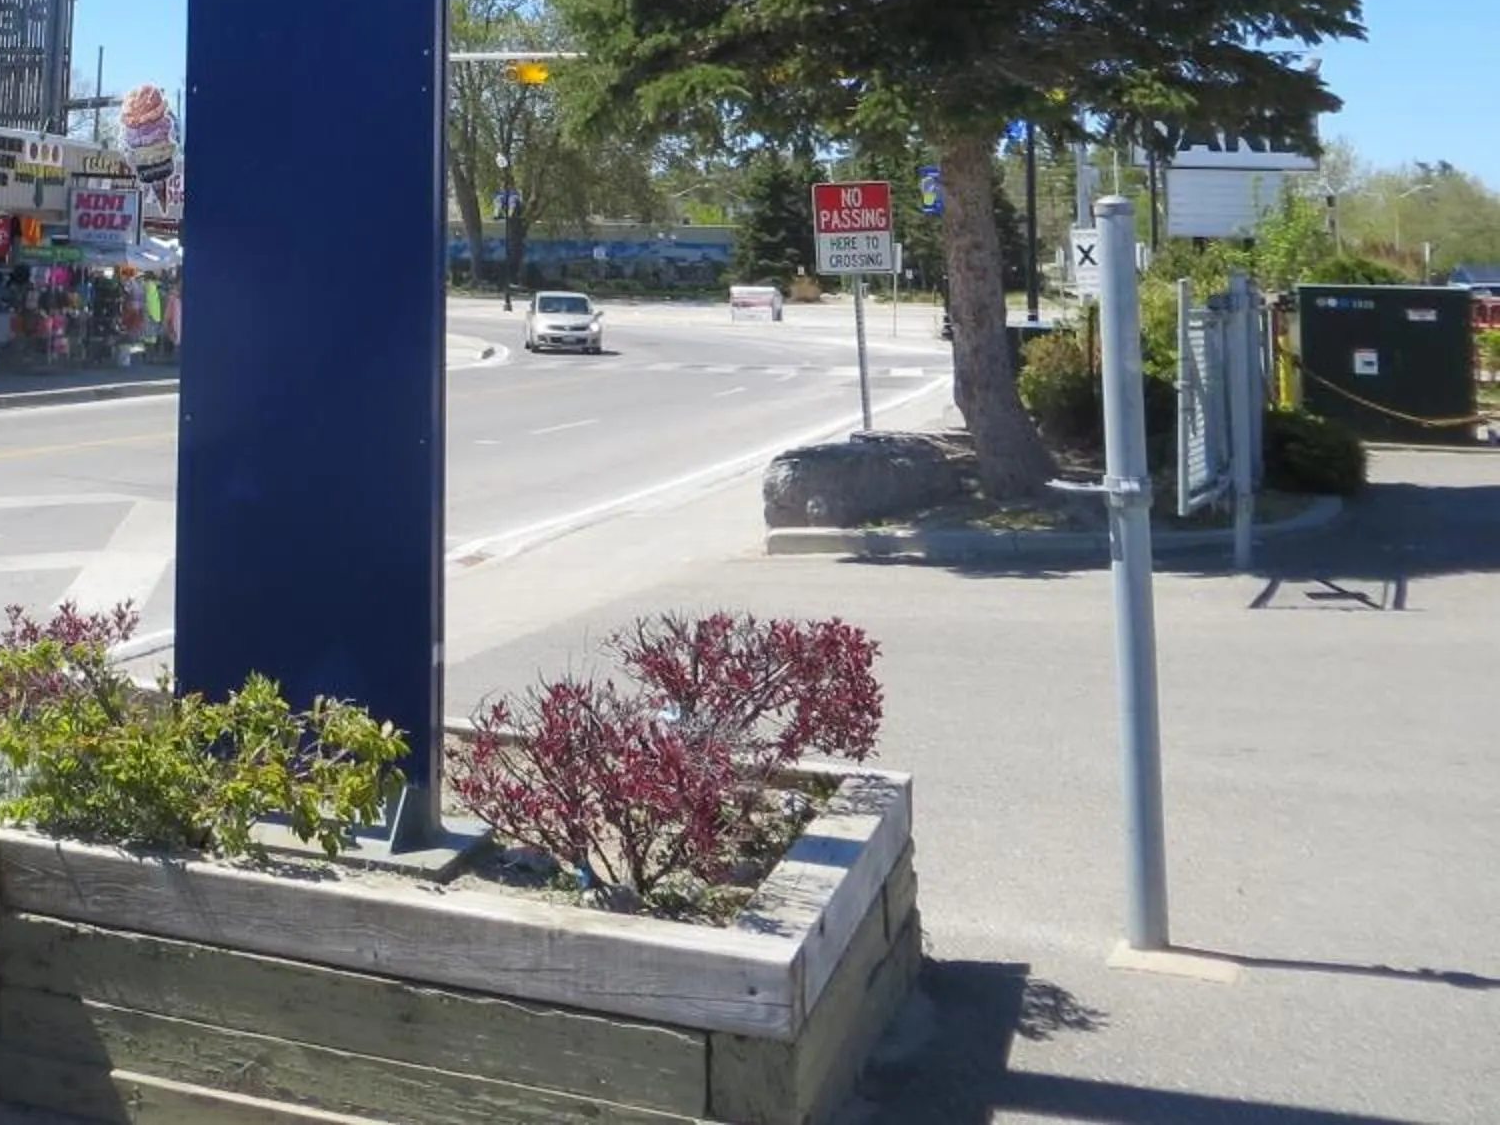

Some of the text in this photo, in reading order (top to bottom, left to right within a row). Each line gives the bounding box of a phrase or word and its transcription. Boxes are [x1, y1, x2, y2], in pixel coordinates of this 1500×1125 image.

[75, 192, 126, 212] MINI
[841, 187, 863, 208] NO
[77, 212, 133, 232] GOLF
[820, 208, 887, 230] PASSING
[829, 235, 879, 251] HERE TO
[829, 253, 883, 268] CROSSING
